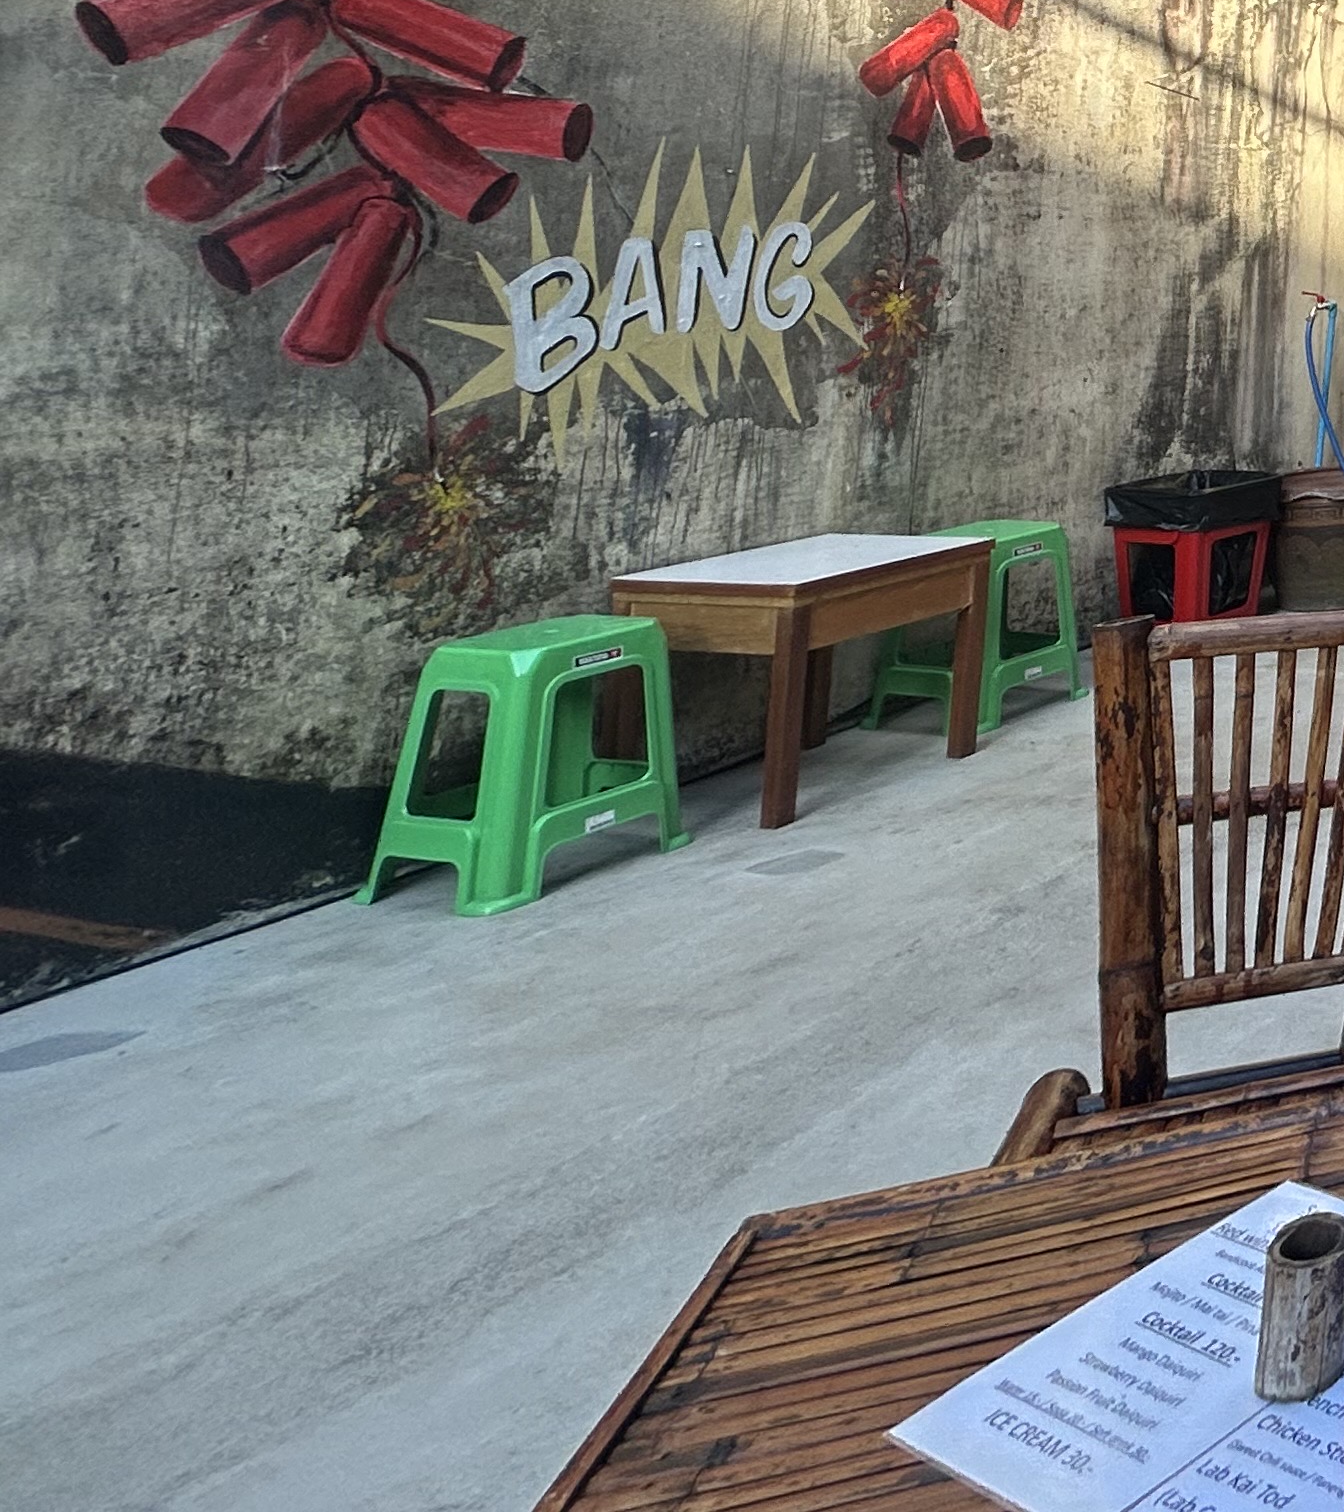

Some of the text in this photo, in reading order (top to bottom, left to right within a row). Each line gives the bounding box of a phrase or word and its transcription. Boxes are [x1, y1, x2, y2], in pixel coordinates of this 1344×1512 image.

[503, 221, 815, 395] BANG
[1141, 1311, 1201, 1343] Cocktail
[984, 1409, 1018, 1431] ICE
[1008, 1421, 1070, 1461] CREAM
[1257, 1413, 1322, 1450] Chicken
[1196, 1456, 1232, 1484] Lab
[1230, 1470, 1262, 1495] Kai
[1257, 1483, 1296, 1510] Tod
